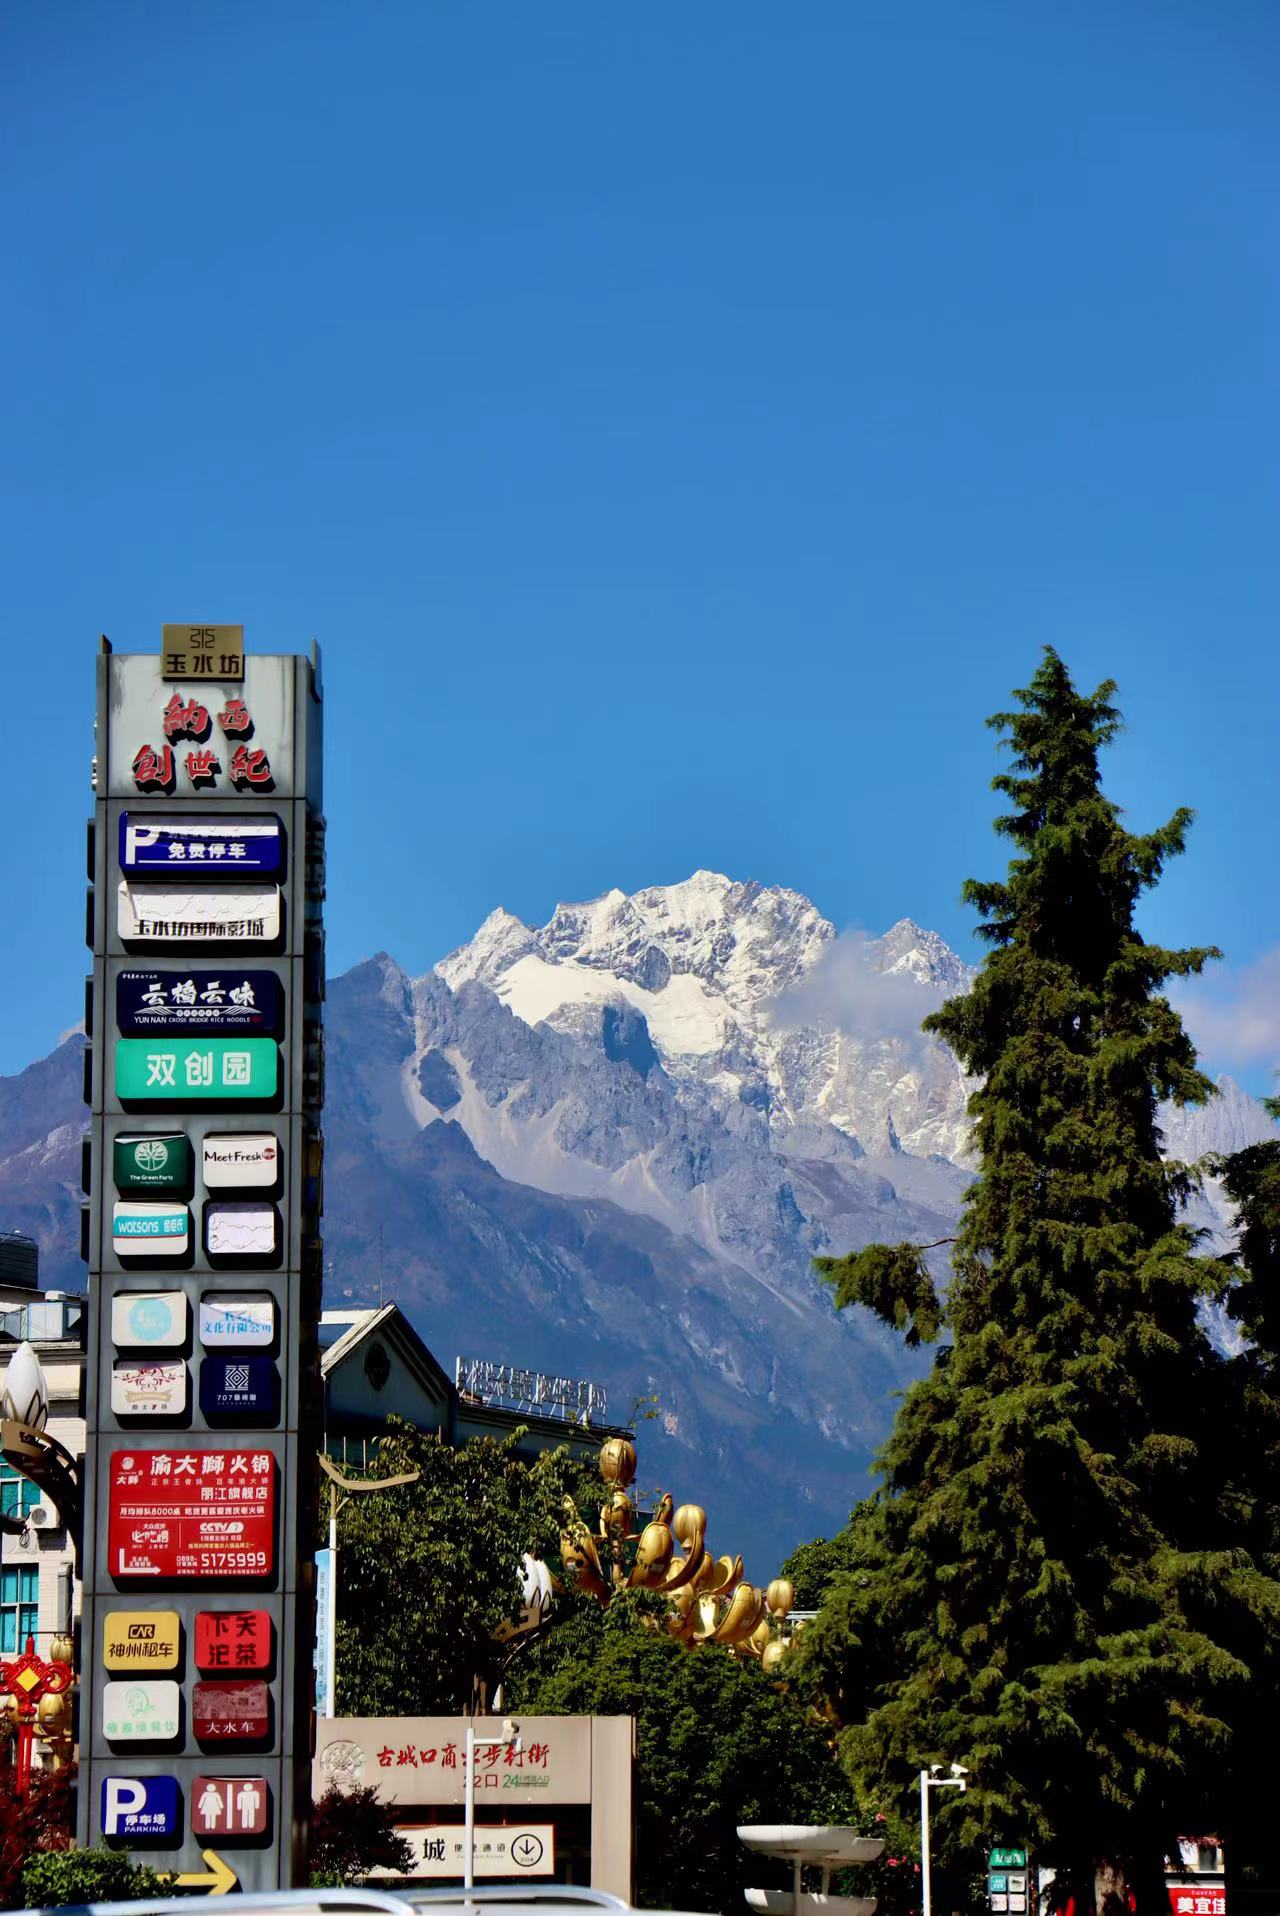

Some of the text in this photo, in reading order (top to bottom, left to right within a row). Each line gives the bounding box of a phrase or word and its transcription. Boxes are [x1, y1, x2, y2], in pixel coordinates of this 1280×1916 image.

[166, 654, 240, 674] 玉水坊
[132, 744, 271, 785] 創世紀
[168, 843, 247, 859] 免费停车
[134, 1016, 150, 1024] YUN
[151, 1016, 167, 1024] NAN
[146, 1051, 251, 1087] 双创园
[204, 1151, 234, 1162] Meet
[234, 1151, 262, 1162] Fresh
[118, 1219, 160, 1233] watsons
[201, 1487, 268, 1500] 丽江旗舰店
[201, 1552, 266, 1567] 5175999
[129, 1625, 154, 1638] CAR
[208, 1615, 257, 1638] 下关
[109, 1642, 173, 1658] 神州租车
[208, 1644, 257, 1665] 沱茶
[206, 1721, 255, 1734] 大水车
[105, 1778, 147, 1835] P
[125, 1813, 166, 1826] 停车场
[1177, 1896, 1226, 1915] 美宜佳
